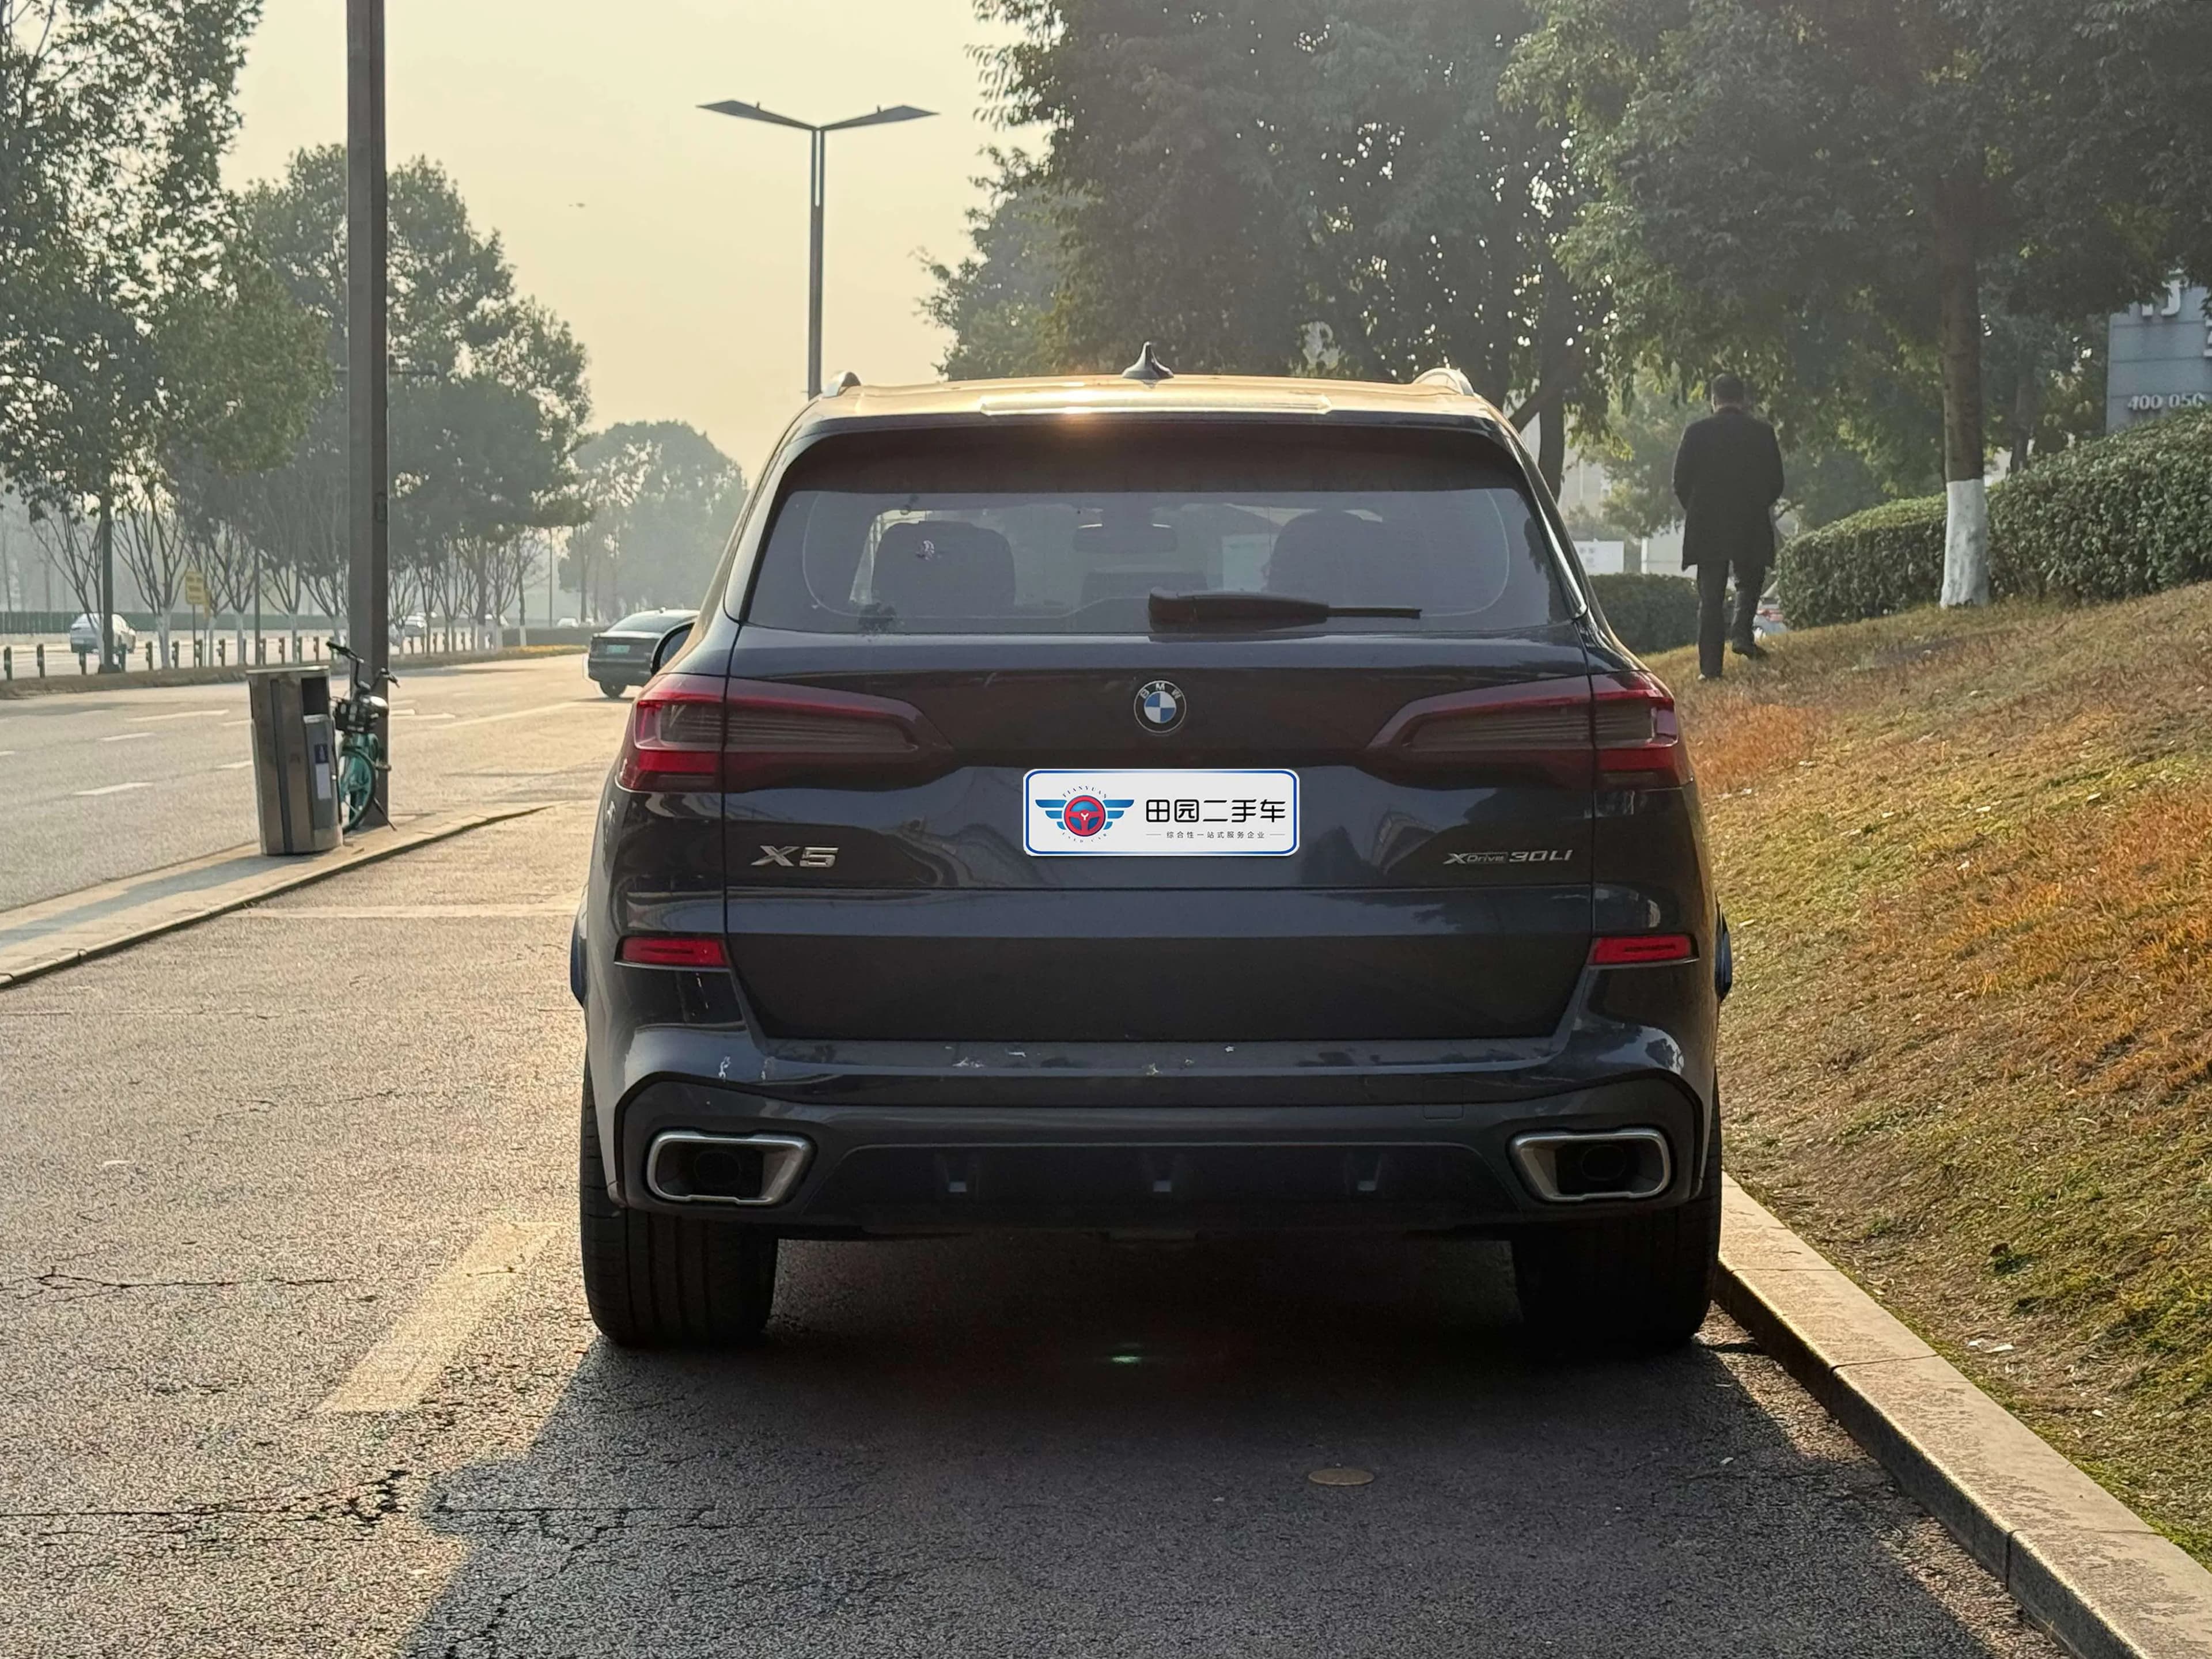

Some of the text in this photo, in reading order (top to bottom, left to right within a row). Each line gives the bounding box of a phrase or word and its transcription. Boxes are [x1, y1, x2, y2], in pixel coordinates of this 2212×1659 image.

[2127, 393, 2163, 411] 400
[1140, 683, 1182, 700] BMW
[751, 844, 839, 868] X5
